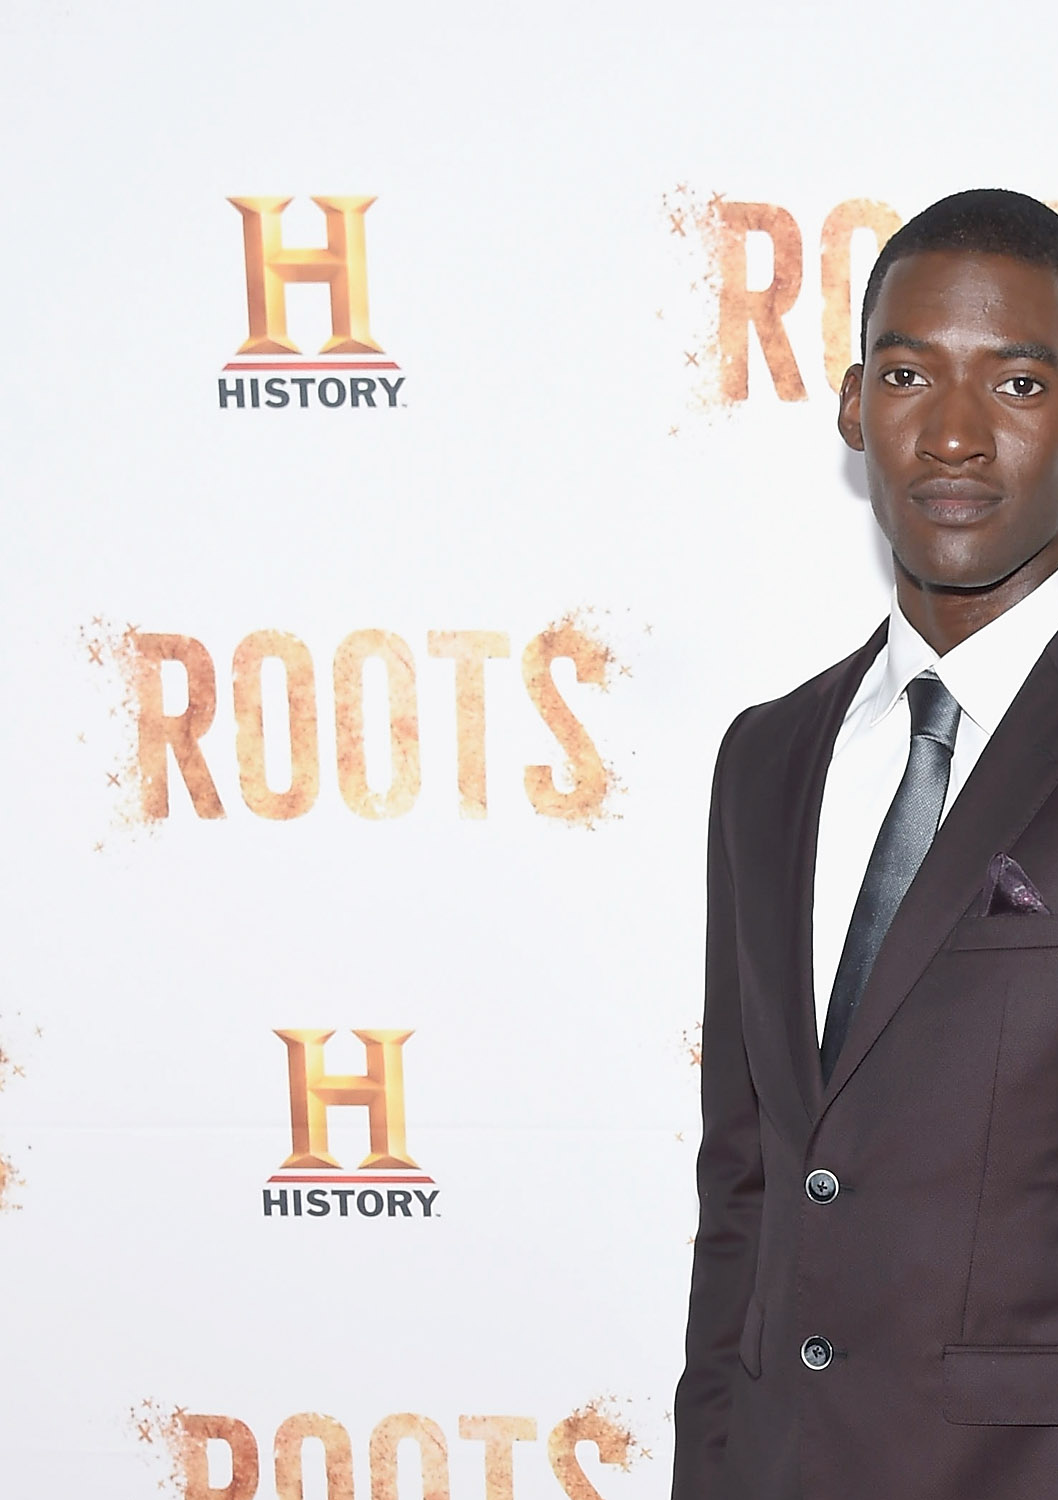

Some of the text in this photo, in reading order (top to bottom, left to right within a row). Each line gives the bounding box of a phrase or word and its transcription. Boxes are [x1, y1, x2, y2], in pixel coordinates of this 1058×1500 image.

[227, 194, 384, 356] H
[219, 377, 406, 408] HISTORY
[138, 627, 612, 823] ROOTS
[273, 1028, 420, 1170] H
[262, 1189, 440, 1217] HISTORY
